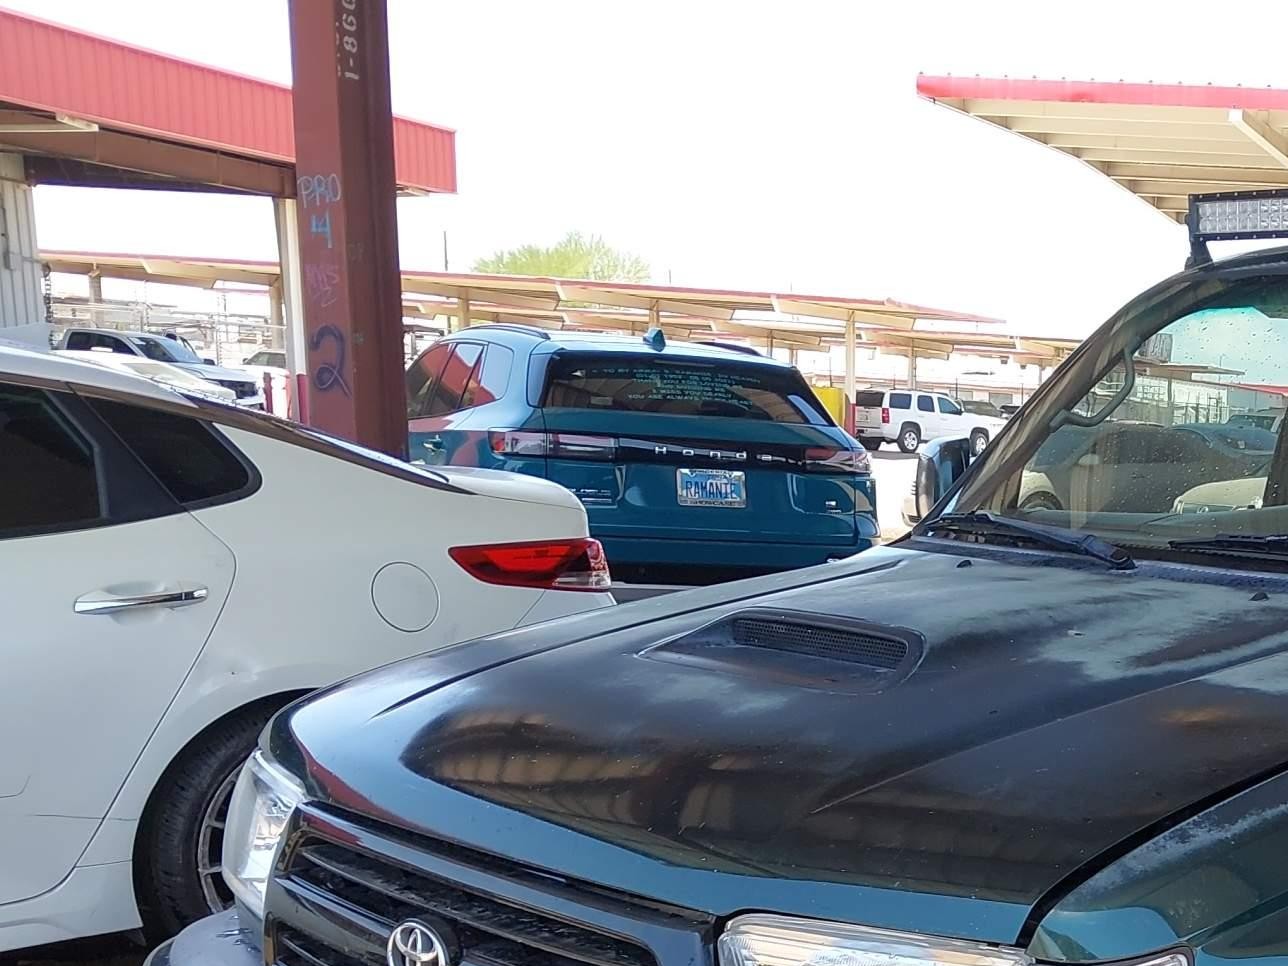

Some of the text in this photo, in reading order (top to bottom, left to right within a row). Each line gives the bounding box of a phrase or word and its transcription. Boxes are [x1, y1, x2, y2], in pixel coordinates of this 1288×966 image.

[297, 173, 341, 208] PRO
[310, 207, 333, 249] 4
[309, 322, 353, 400] 2
[685, 480, 738, 500] RAMANIE
